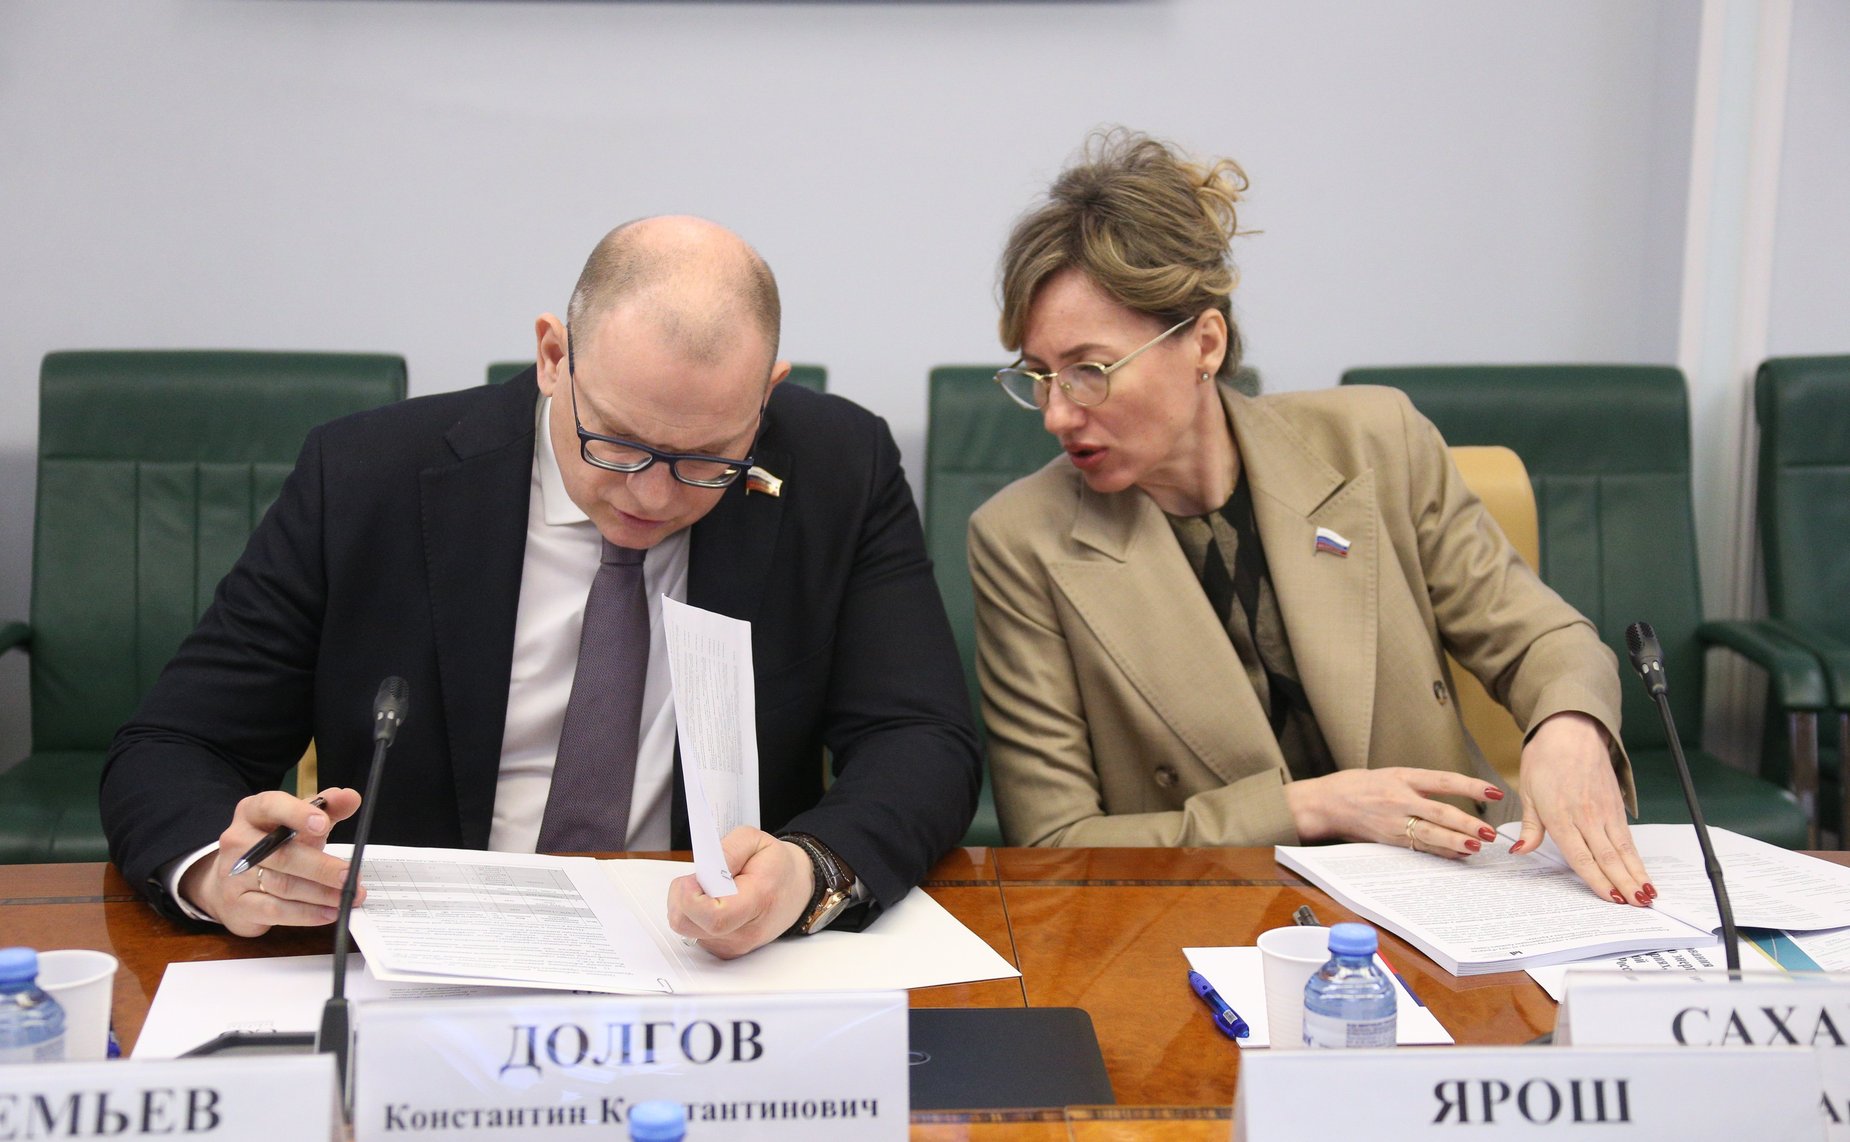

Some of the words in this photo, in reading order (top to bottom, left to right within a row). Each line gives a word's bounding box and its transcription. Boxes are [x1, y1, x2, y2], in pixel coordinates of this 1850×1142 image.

[499, 1019, 765, 1077] ДОЛГОВ
[384, 1103, 588, 1132] Константин
[600, 1097, 879, 1125] Ктантинович
[1431, 1078, 1632, 1125] ЯРОШ
